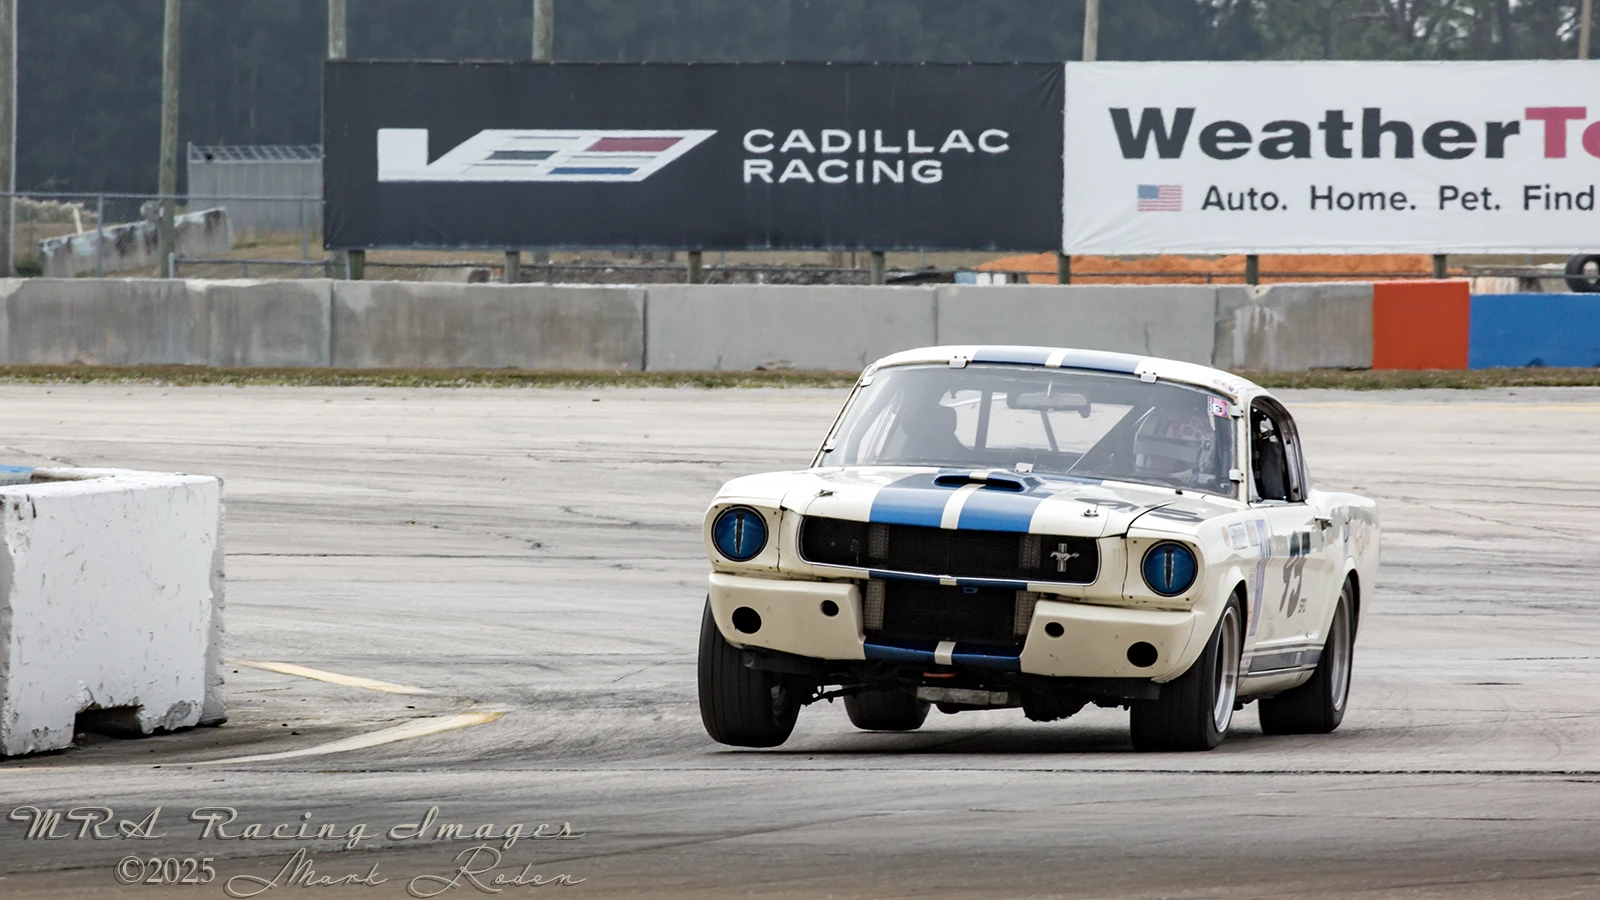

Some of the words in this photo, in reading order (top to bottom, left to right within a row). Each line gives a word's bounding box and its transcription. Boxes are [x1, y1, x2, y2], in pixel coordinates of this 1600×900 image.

[742, 128, 1010, 154] CADILLAC
[743, 158, 943, 184] RACING
[1201, 184, 1289, 212] Auto.
[1310, 184, 1417, 212] Home.
[1439, 184, 1501, 212] Pet.
[1523, 183, 1595, 211] Find
